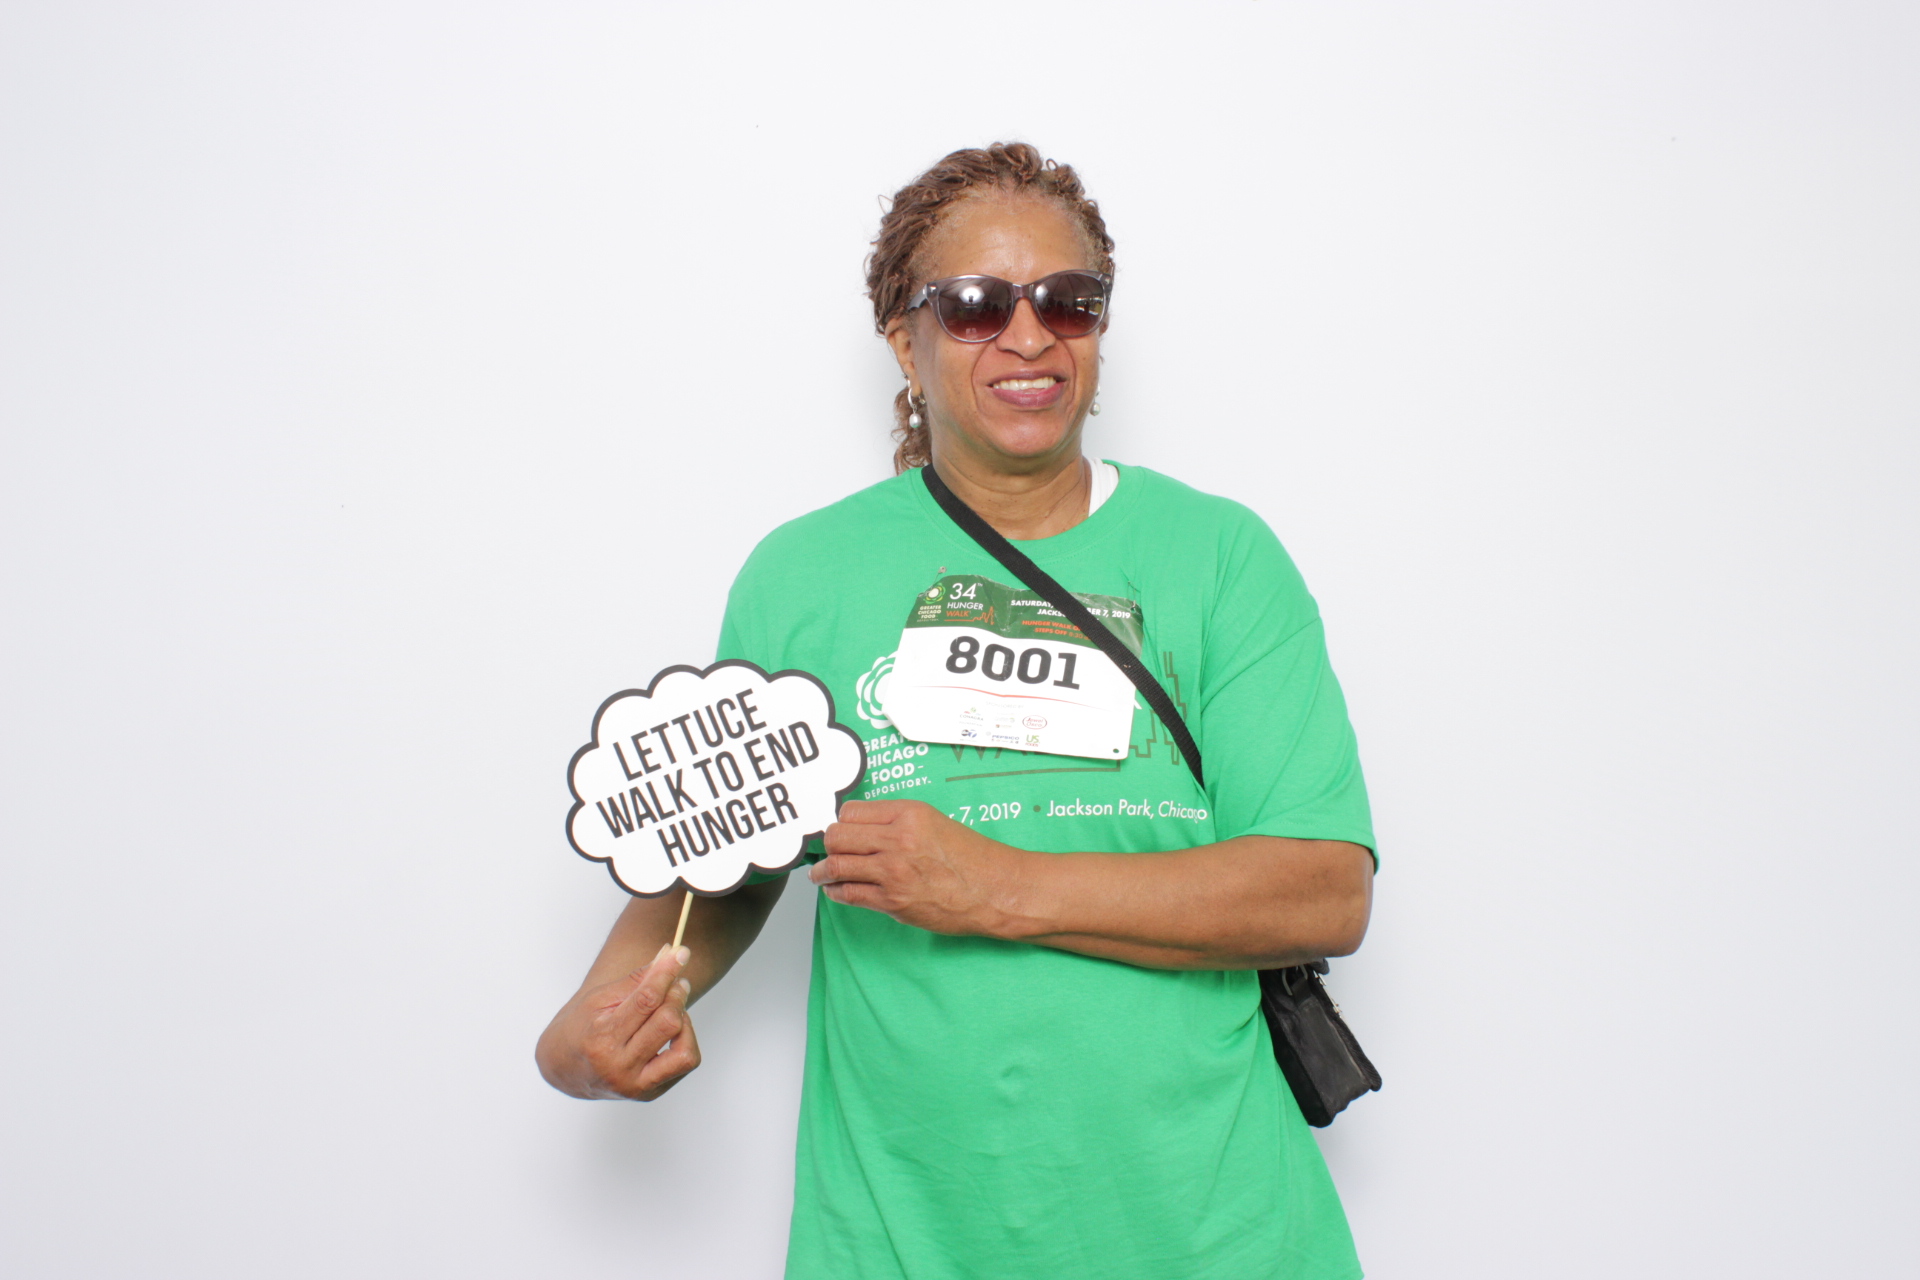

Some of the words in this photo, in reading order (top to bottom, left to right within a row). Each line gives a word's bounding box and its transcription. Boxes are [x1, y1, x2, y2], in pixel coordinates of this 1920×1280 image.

[946, 602, 984, 611] HUNGER
[1037, 608, 1066, 617] JACKS
[1102, 609, 1110, 618] 7,
[1111, 610, 1131, 619] 2019
[1052, 622, 1072, 630] WALK
[946, 636, 1080, 690] 8001
[612, 688, 768, 782] LETTUCE
[863, 732, 911, 754] GREAT
[1025, 733, 1040, 744] US
[867, 743, 929, 769] HICAGO
[596, 768, 698, 838] WALK
[693, 751, 745, 800] TO
[743, 721, 820, 782] END
[871, 763, 915, 785] FOOD
[864, 776, 929, 799] DEPOSITORY
[959, 806, 974, 826] 7,
[979, 802, 1022, 822] 2019
[1047, 798, 1113, 817] Jackson
[1118, 798, 1155, 820] Park,
[1158, 801, 1208, 824] Chicago
[656, 782, 799, 868] HUNGER
